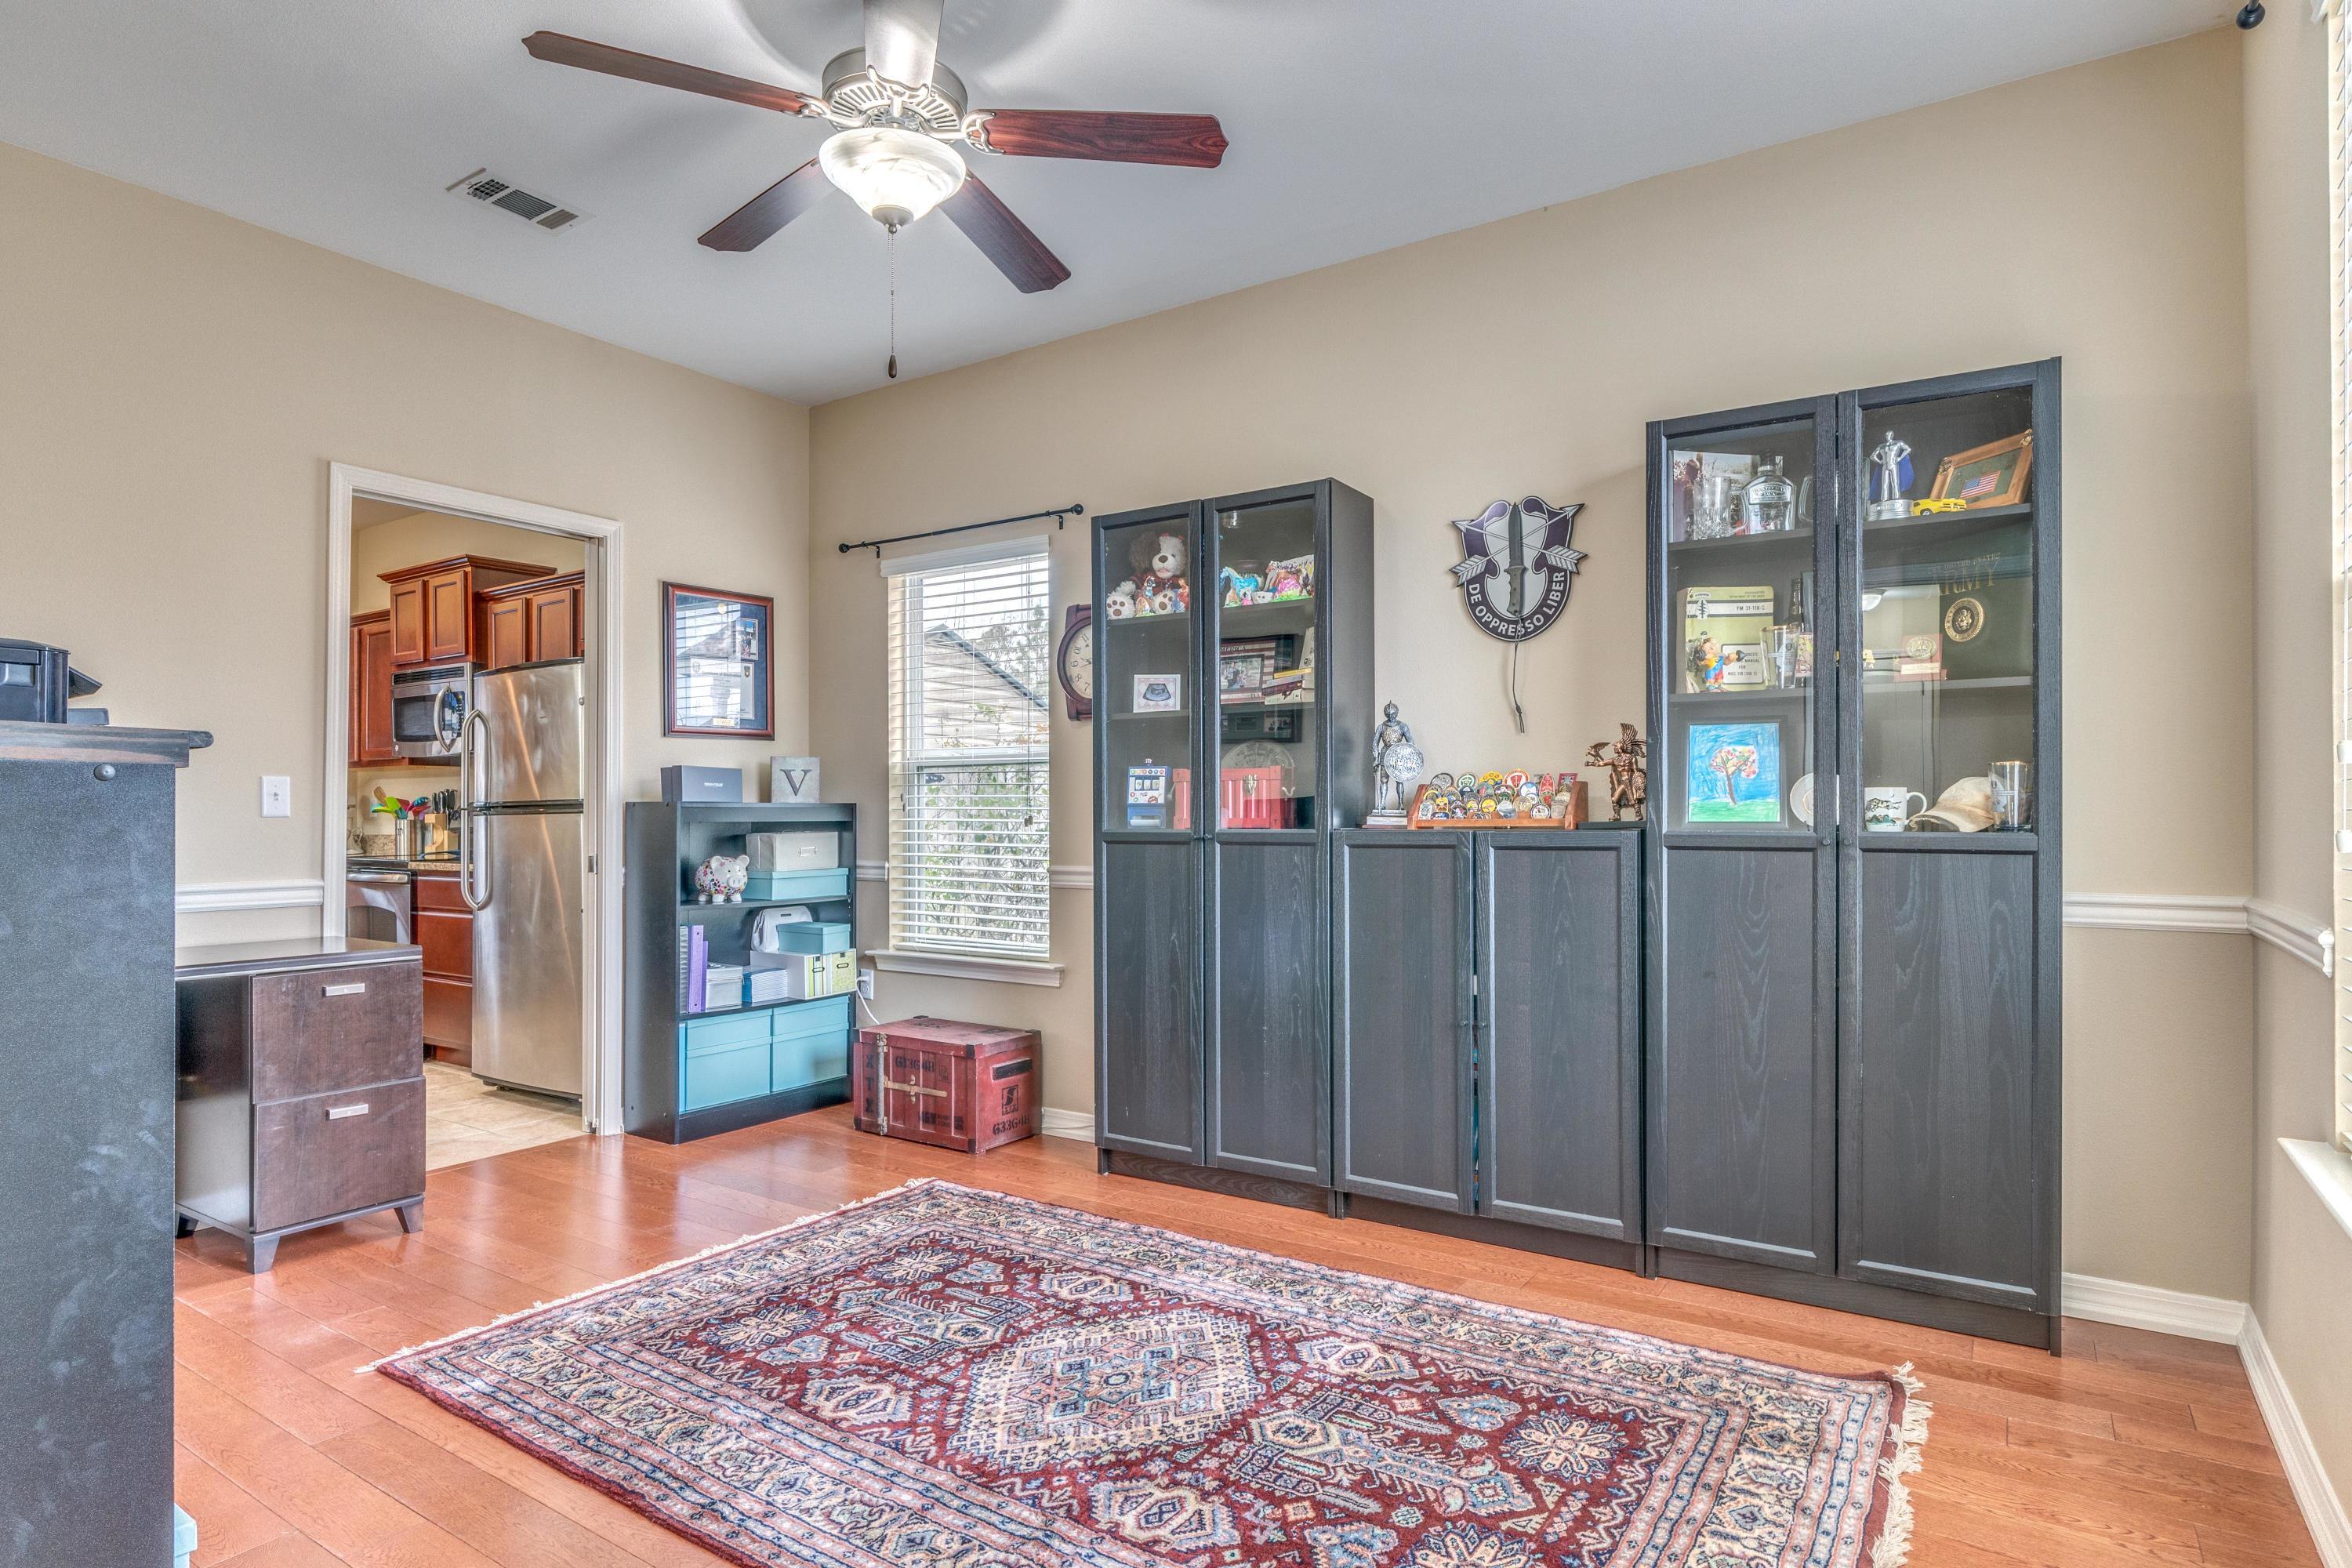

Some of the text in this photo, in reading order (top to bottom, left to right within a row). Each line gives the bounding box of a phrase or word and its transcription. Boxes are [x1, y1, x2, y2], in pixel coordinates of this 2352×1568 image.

[1927, 560, 1999, 600] ARMY
[1468, 572, 1565, 636] DE OPPRESSO LIBER
[1074, 673, 1083, 682] 8
[1084, 682, 1091, 692] 7
[779, 768, 812, 797] V
